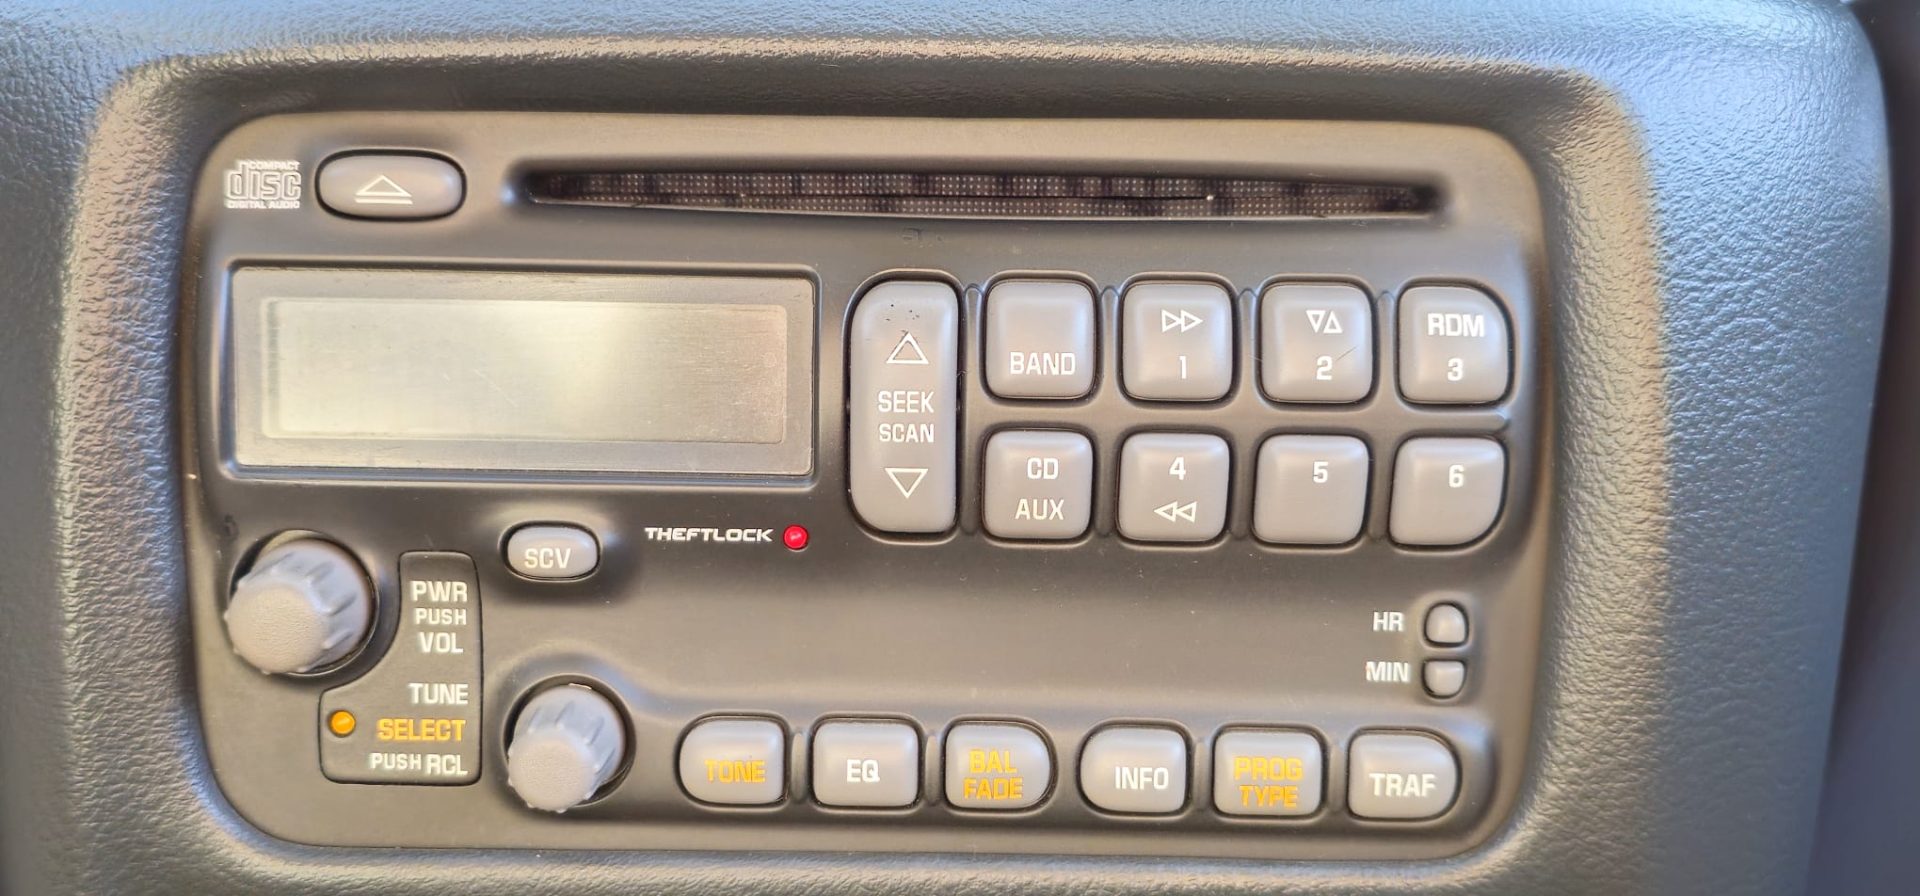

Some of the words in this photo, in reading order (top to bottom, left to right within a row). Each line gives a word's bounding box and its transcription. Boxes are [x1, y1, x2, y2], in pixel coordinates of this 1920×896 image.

[248, 160, 300, 170] COMPACT
[226, 161, 301, 200] disc
[226, 200, 266, 209] DIGITAL
[268, 200, 300, 209] AUDIO
[1427, 313, 1485, 338] RDM
[1009, 352, 1077, 377] BAND
[1178, 356, 1188, 380] 1
[1316, 356, 1334, 381] 2
[1446, 358, 1464, 382] 3
[877, 391, 935, 414] SEEK
[878, 423, 936, 444] SCAN
[1026, 457, 1060, 481] CD
[1168, 456, 1187, 481] 4
[1313, 461, 1329, 485] 5
[1447, 464, 1465, 489] 6
[1014, 497, 1065, 522] AUX
[645, 526, 774, 544] THEFTLOCK
[523, 547, 571, 570] SCV
[411, 580, 468, 603] PWR
[414, 607, 468, 626] PUSH
[1372, 611, 1405, 633] HR
[419, 631, 464, 654] VOL
[1365, 661, 1410, 683] MIN
[408, 682, 469, 705] TUNE
[376, 718, 467, 742] SELECT
[369, 752, 422, 771] PUSH
[426, 754, 468, 776] RCL
[704, 759, 766, 784] TONE
[846, 759, 880, 784] EQ
[968, 750, 1018, 774] BAL
[1233, 756, 1304, 782] PROG
[963, 776, 1023, 801] FADE
[1114, 765, 1170, 791] INFO
[1369, 772, 1438, 798] TRAF
[1239, 784, 1299, 808] TYPE
